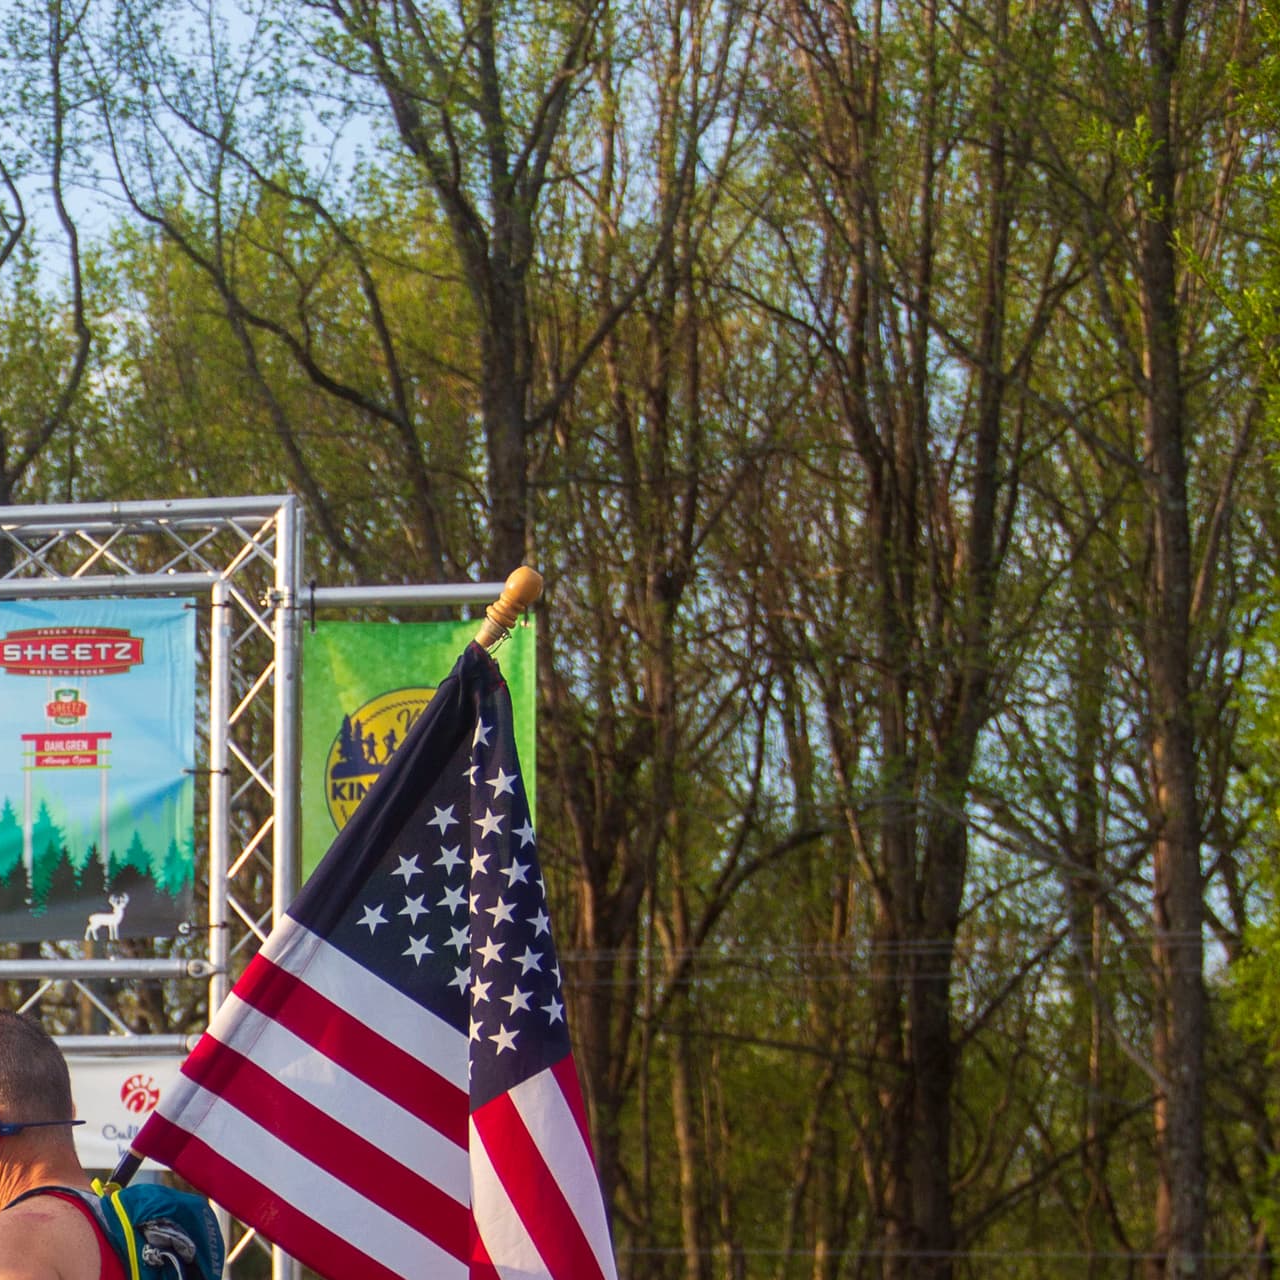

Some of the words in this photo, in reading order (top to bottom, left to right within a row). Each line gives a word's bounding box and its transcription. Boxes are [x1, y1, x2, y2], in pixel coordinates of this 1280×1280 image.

[2, 642, 133, 662] SHEETZ
[43, 740, 89, 752] DAHLGREN
[72, 755, 93, 766] Open
